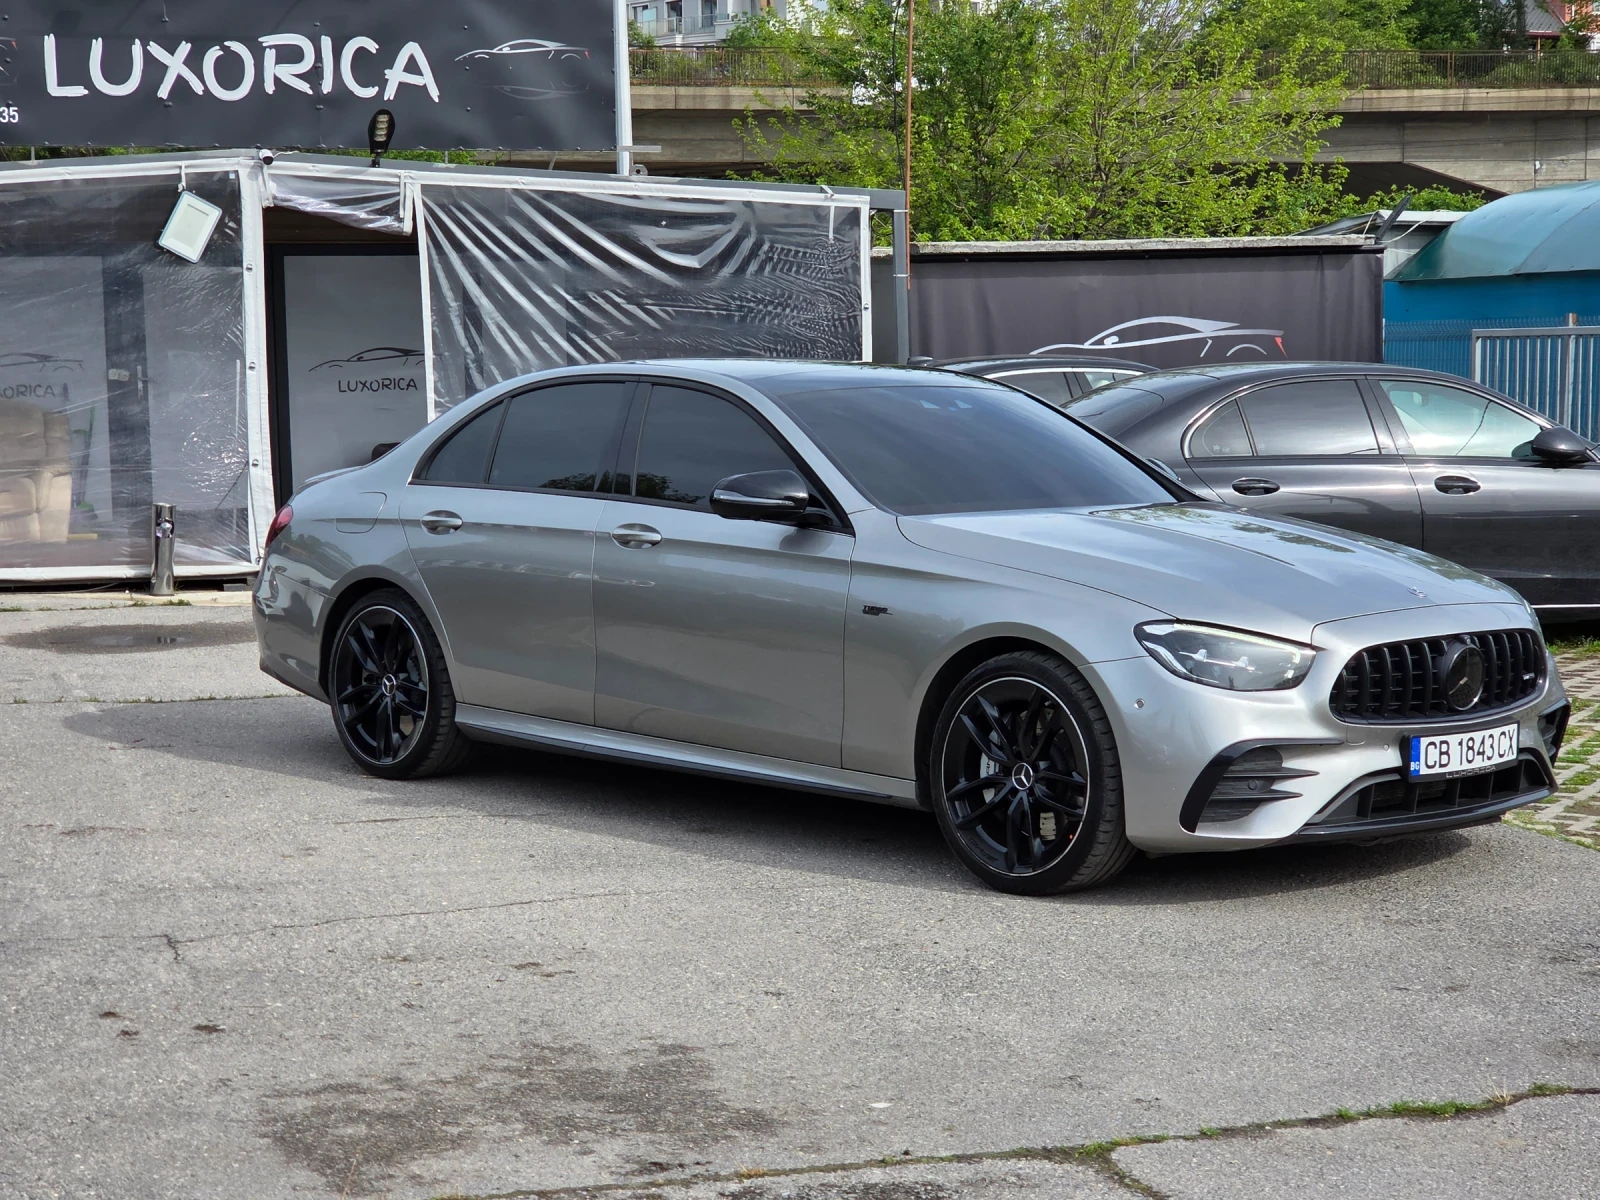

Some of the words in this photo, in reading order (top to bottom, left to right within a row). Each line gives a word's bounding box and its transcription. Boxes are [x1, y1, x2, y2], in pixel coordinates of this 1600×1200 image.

[44, 33, 440, 102] LUXORICA
[0, 384, 56, 399] ORICA
[338, 377, 418, 393] LUXORICA
[1424, 739, 1451, 769] CB
[1458, 733, 1495, 766] 1843
[1497, 728, 1515, 758] CX
[1410, 761, 1420, 771] BG
